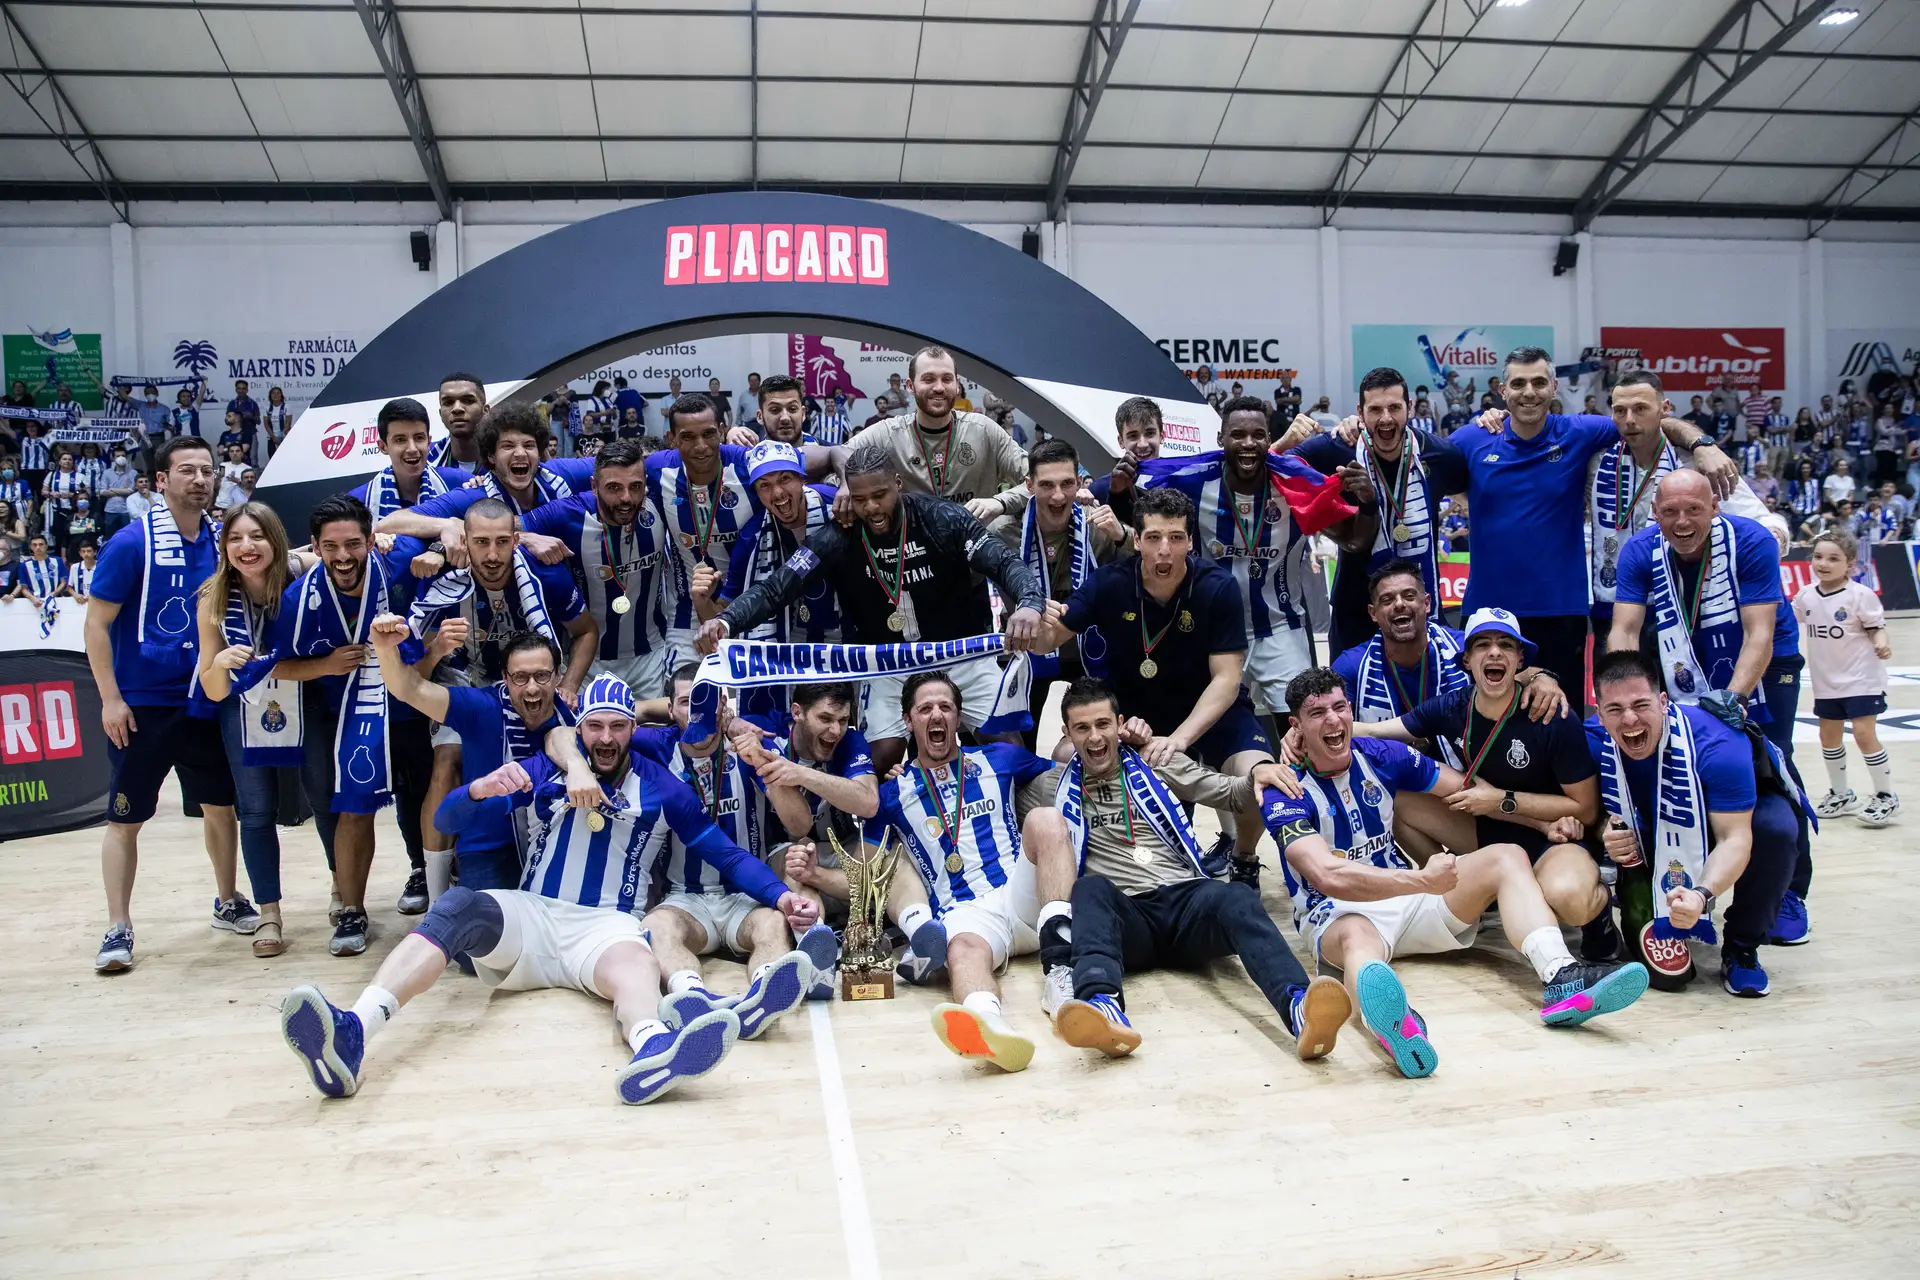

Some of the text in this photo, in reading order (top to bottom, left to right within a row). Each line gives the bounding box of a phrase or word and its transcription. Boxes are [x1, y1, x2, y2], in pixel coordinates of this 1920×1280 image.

[668, 229, 885, 279] PLACARD
[288, 336, 357, 354] FARMÁCIA
[1433, 343, 1497, 365] Vitalis
[228, 358, 315, 378] MARTINS
[876, 354, 907, 363] TÉCNICO
[628, 369, 638, 379] o
[643, 365, 713, 383] desporto
[618, 550, 662, 577] BETANO
[1097, 784, 1113, 803] 16
[1348, 829, 1391, 861] BETANO
